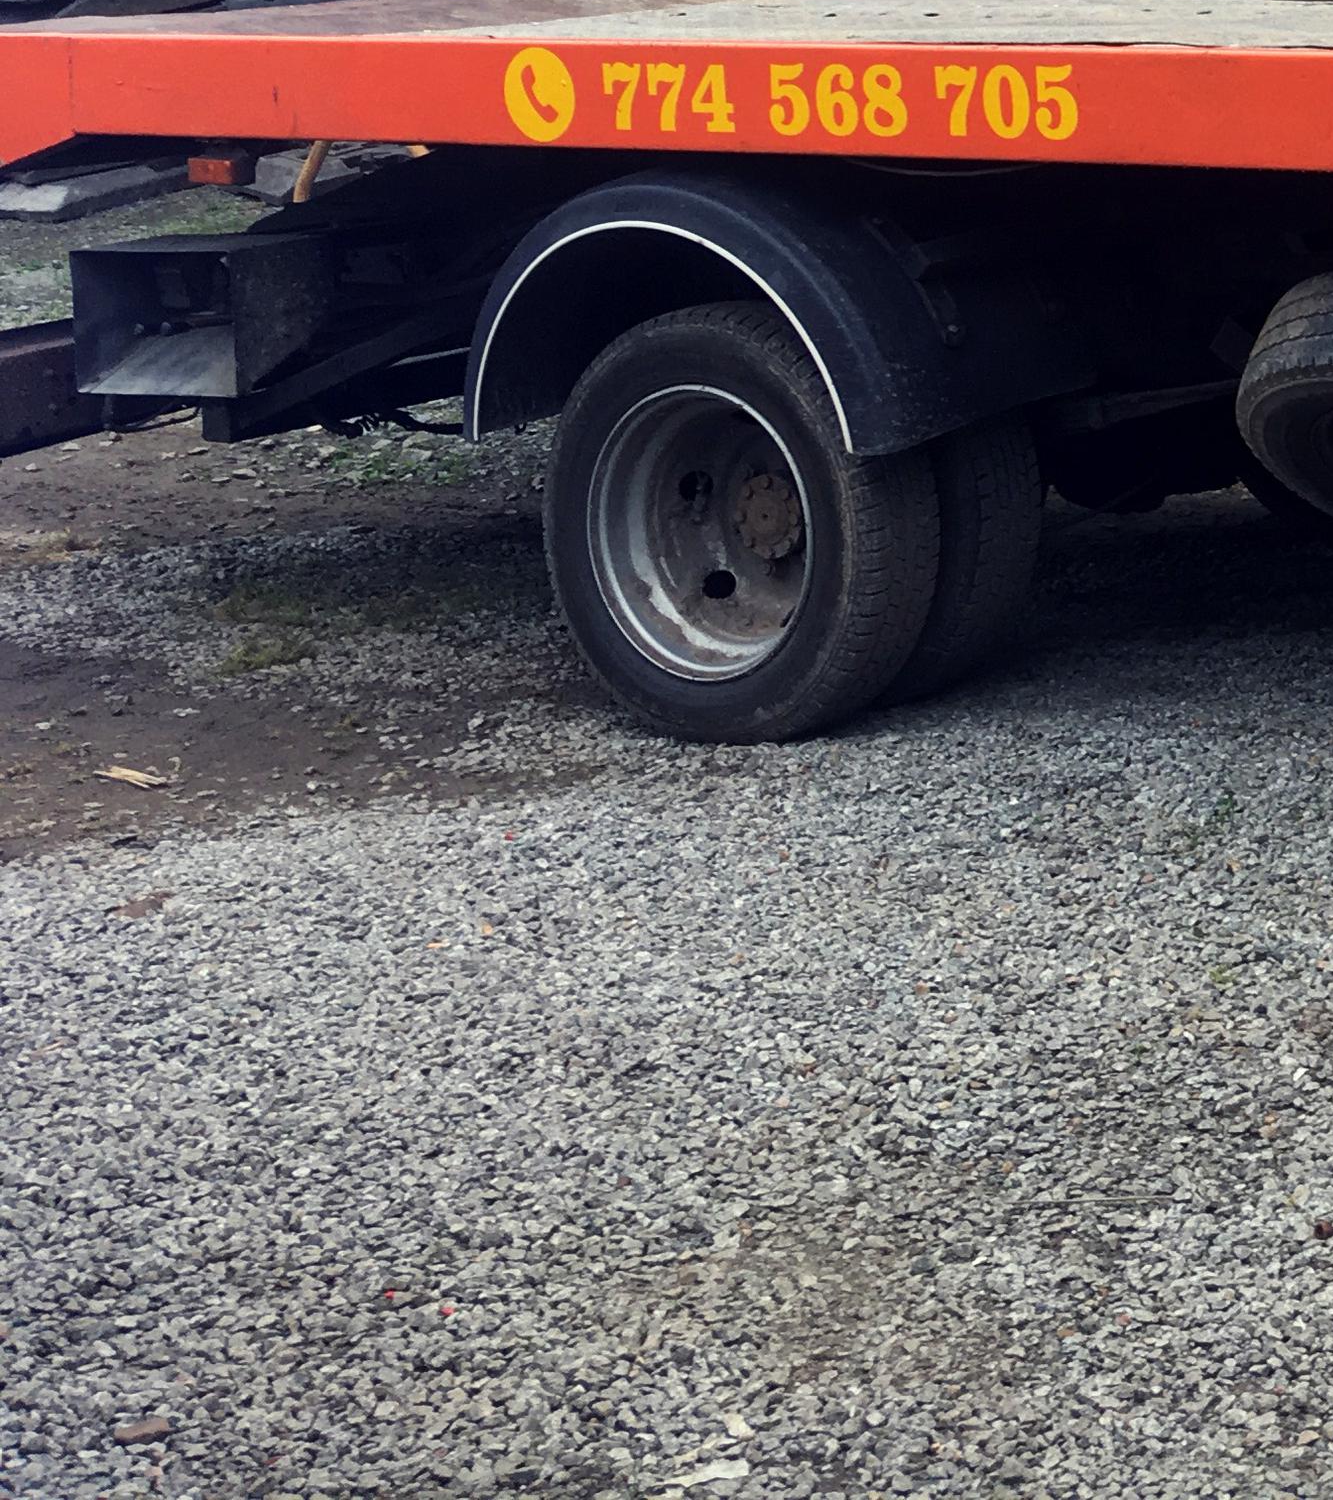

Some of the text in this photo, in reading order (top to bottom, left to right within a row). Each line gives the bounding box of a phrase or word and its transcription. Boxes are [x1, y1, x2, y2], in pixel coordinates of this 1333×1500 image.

[602, 62, 1078, 141] 774 568 705
